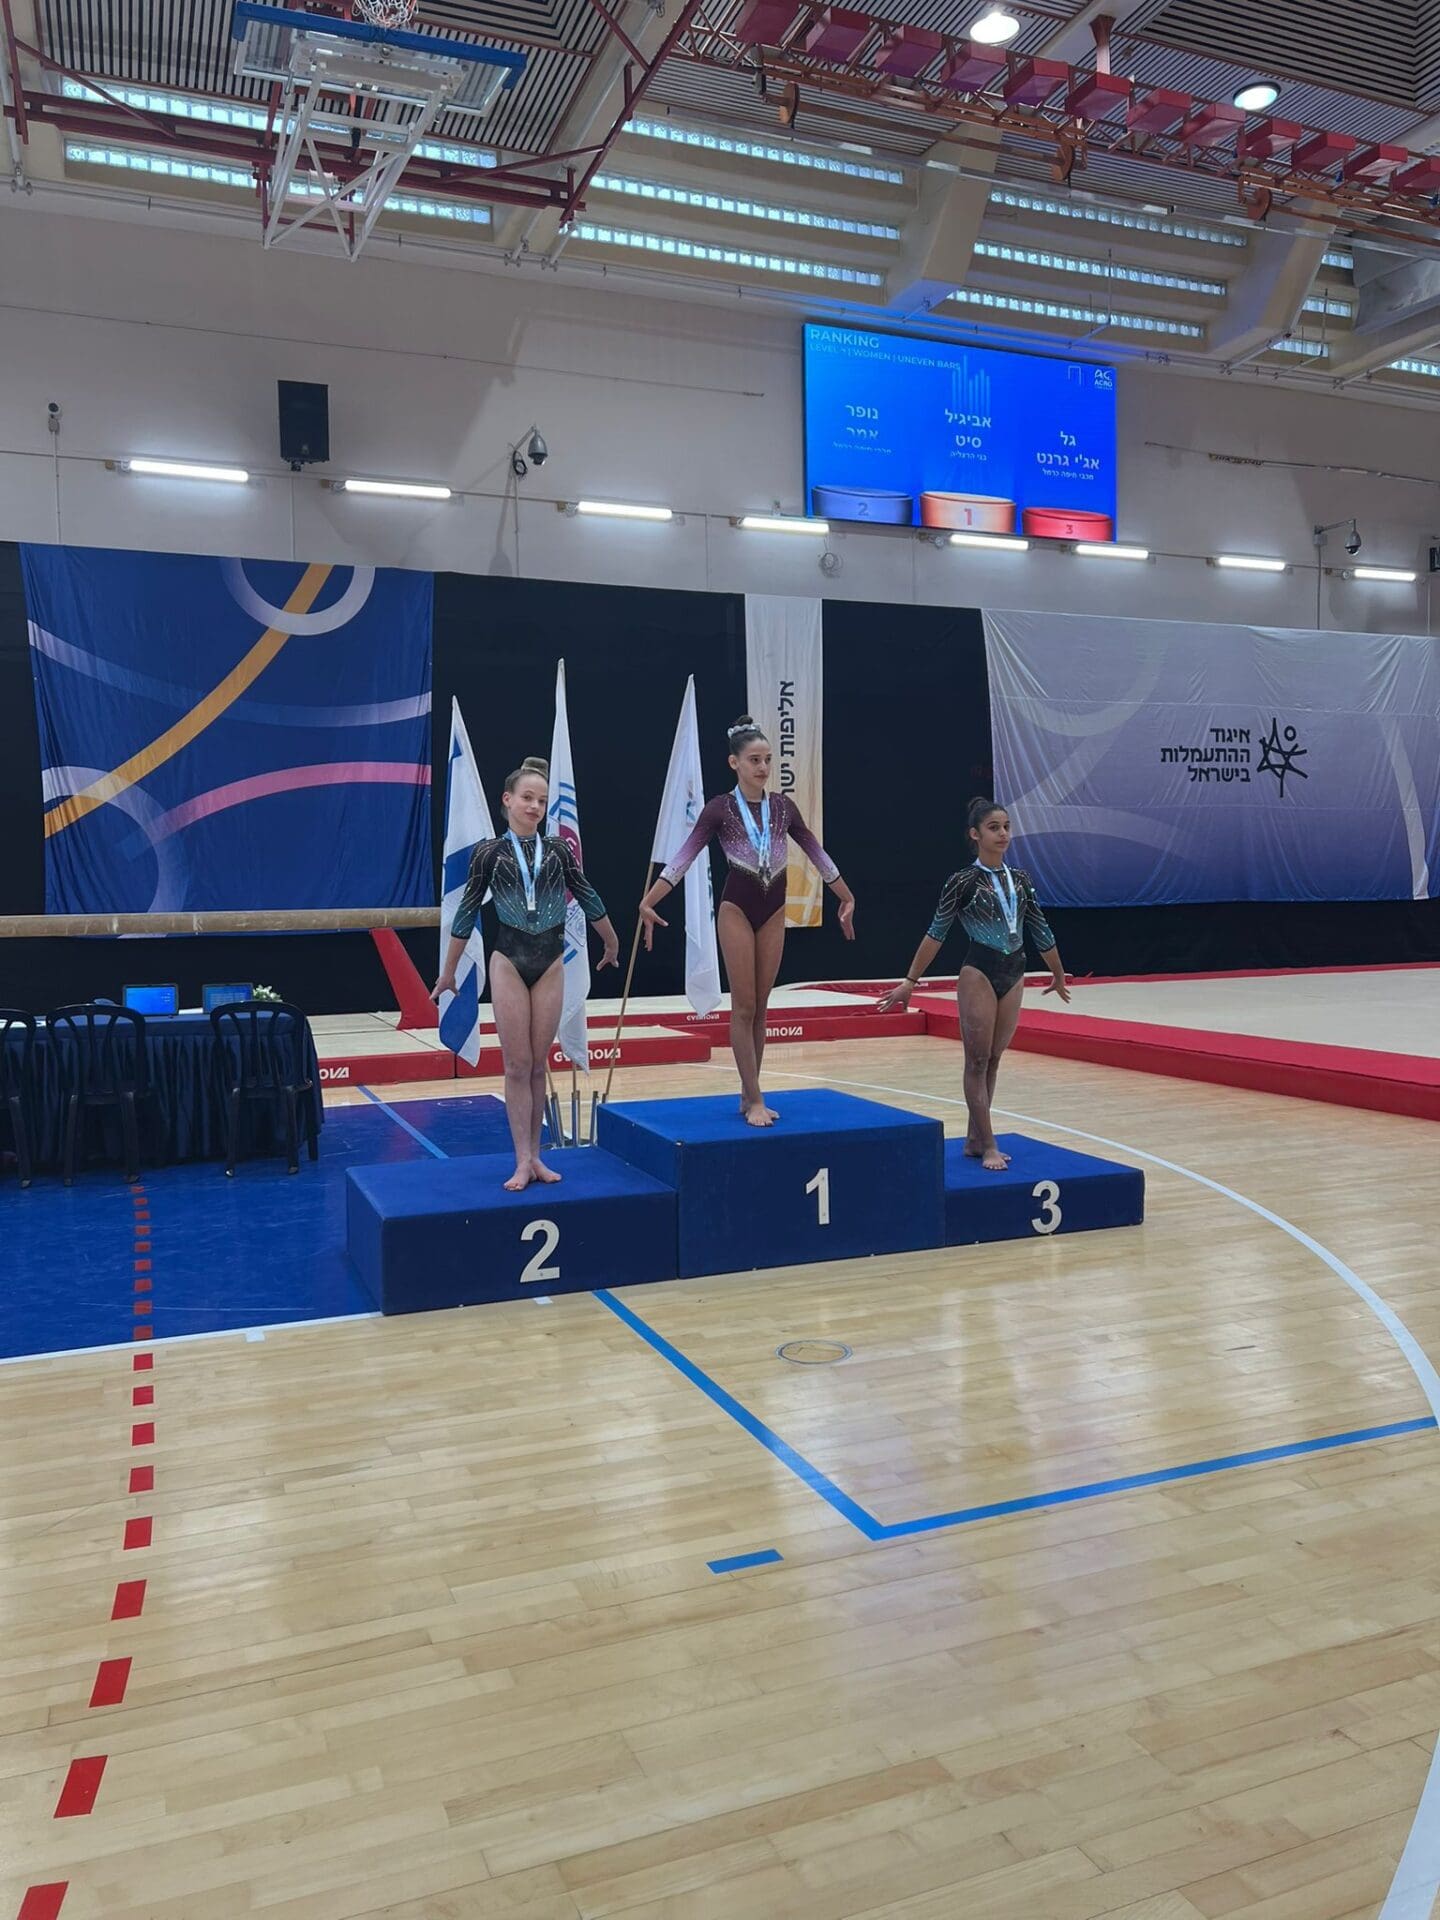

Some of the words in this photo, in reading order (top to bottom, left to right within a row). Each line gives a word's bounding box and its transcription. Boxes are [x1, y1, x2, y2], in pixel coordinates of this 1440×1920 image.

[810, 328, 880, 349] RANKING
[854, 349, 891, 361] WOMEN
[897, 354, 935, 367] UNEVEN
[937, 360, 961, 370] BARS
[845, 404, 879, 420] נופר
[944, 408, 992, 428] אביגיל
[846, 427, 879, 440] אמר
[955, 434, 982, 449] סיט
[1060, 430, 1076, 447] גל
[1036, 452, 1070, 467] גרנט
[1074, 453, 1100, 470] אג'י
[1042, 467, 1060, 477] כרמל
[1060, 470, 1077, 479] חיפה
[1079, 472, 1095, 481] מכבי
[857, 502, 870, 516] 2
[963, 507, 973, 526] 1
[1065, 523, 1074, 535] 3
[778, 680, 795, 758] אליפות
[1209, 728, 1251, 744] איגוד
[1160, 745, 1251, 763] ההתעמלות
[780, 762, 795, 796] ישר
[1187, 764, 1251, 783] בישראל
[318, 1066, 350, 1080] OVA
[804, 1167, 831, 1226] 1
[1031, 1180, 1063, 1234] 3
[519, 1219, 561, 1284] 2
